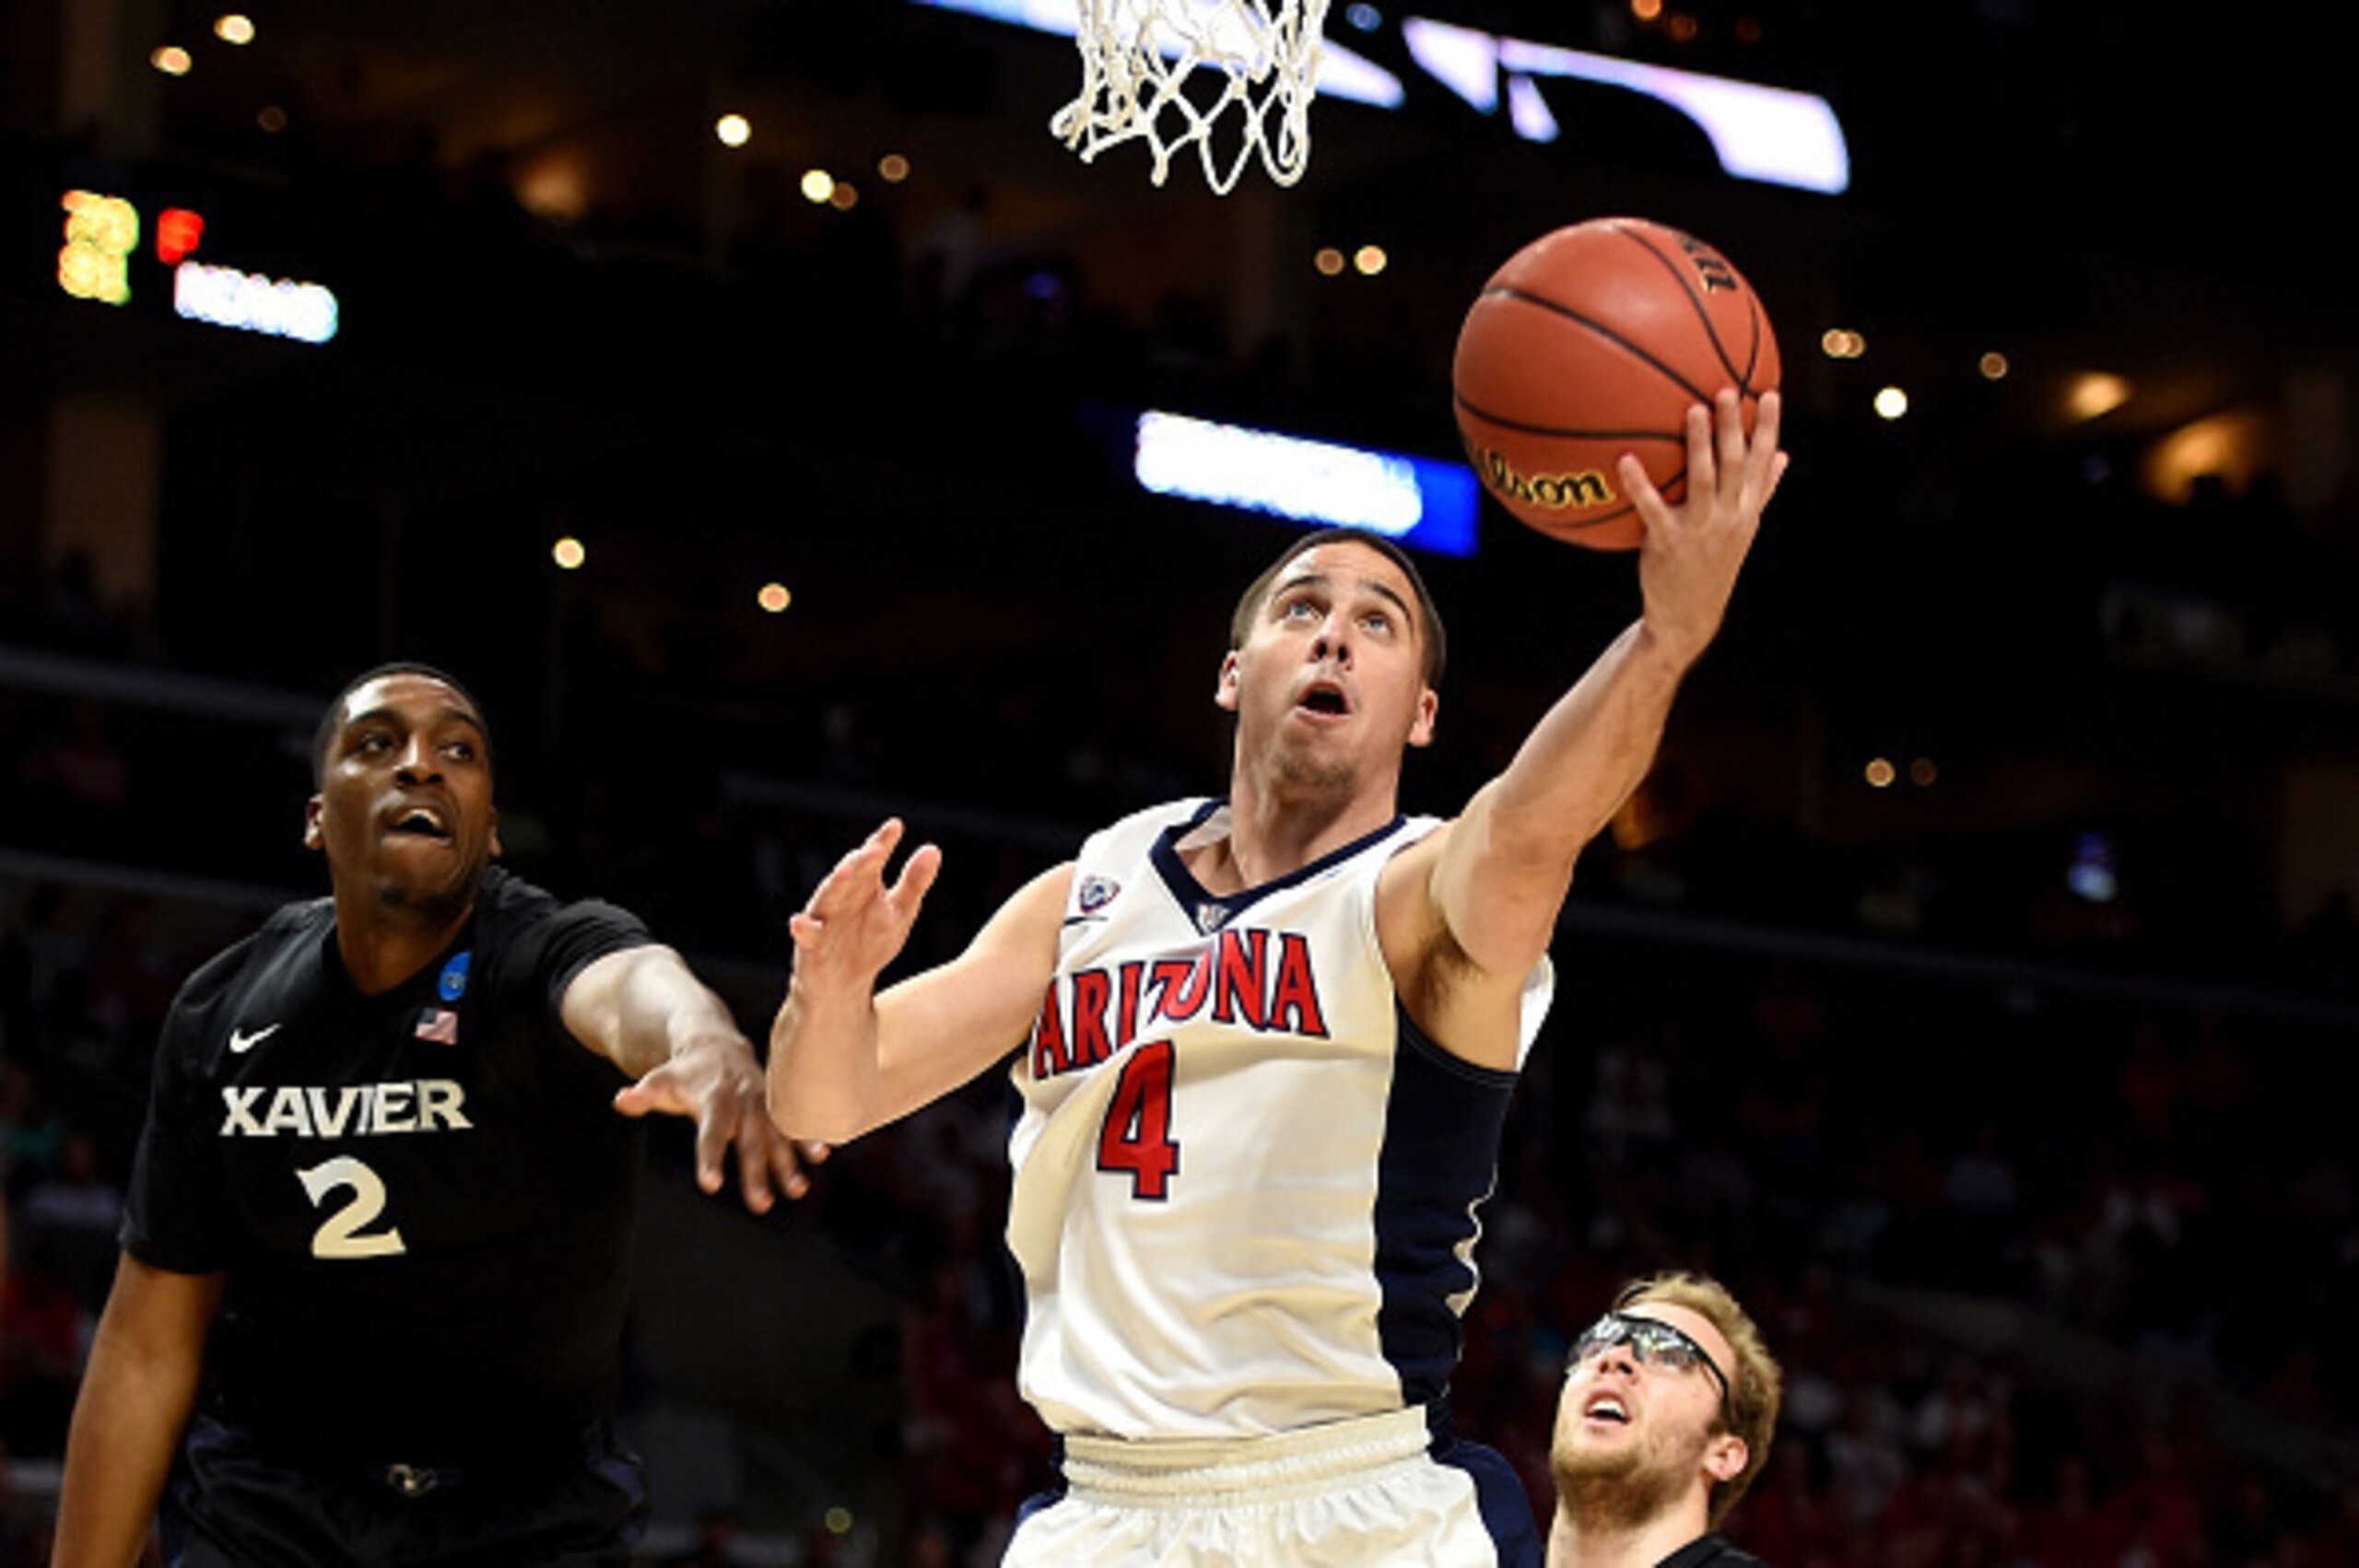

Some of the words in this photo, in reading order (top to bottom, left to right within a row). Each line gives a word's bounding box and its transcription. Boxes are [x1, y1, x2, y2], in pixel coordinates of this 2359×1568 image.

[1033, 930, 1331, 1081] ARIZONA
[220, 1080, 474, 1138] XAVIER
[1097, 1038, 1180, 1201] 4
[294, 1155, 406, 1258] 2
